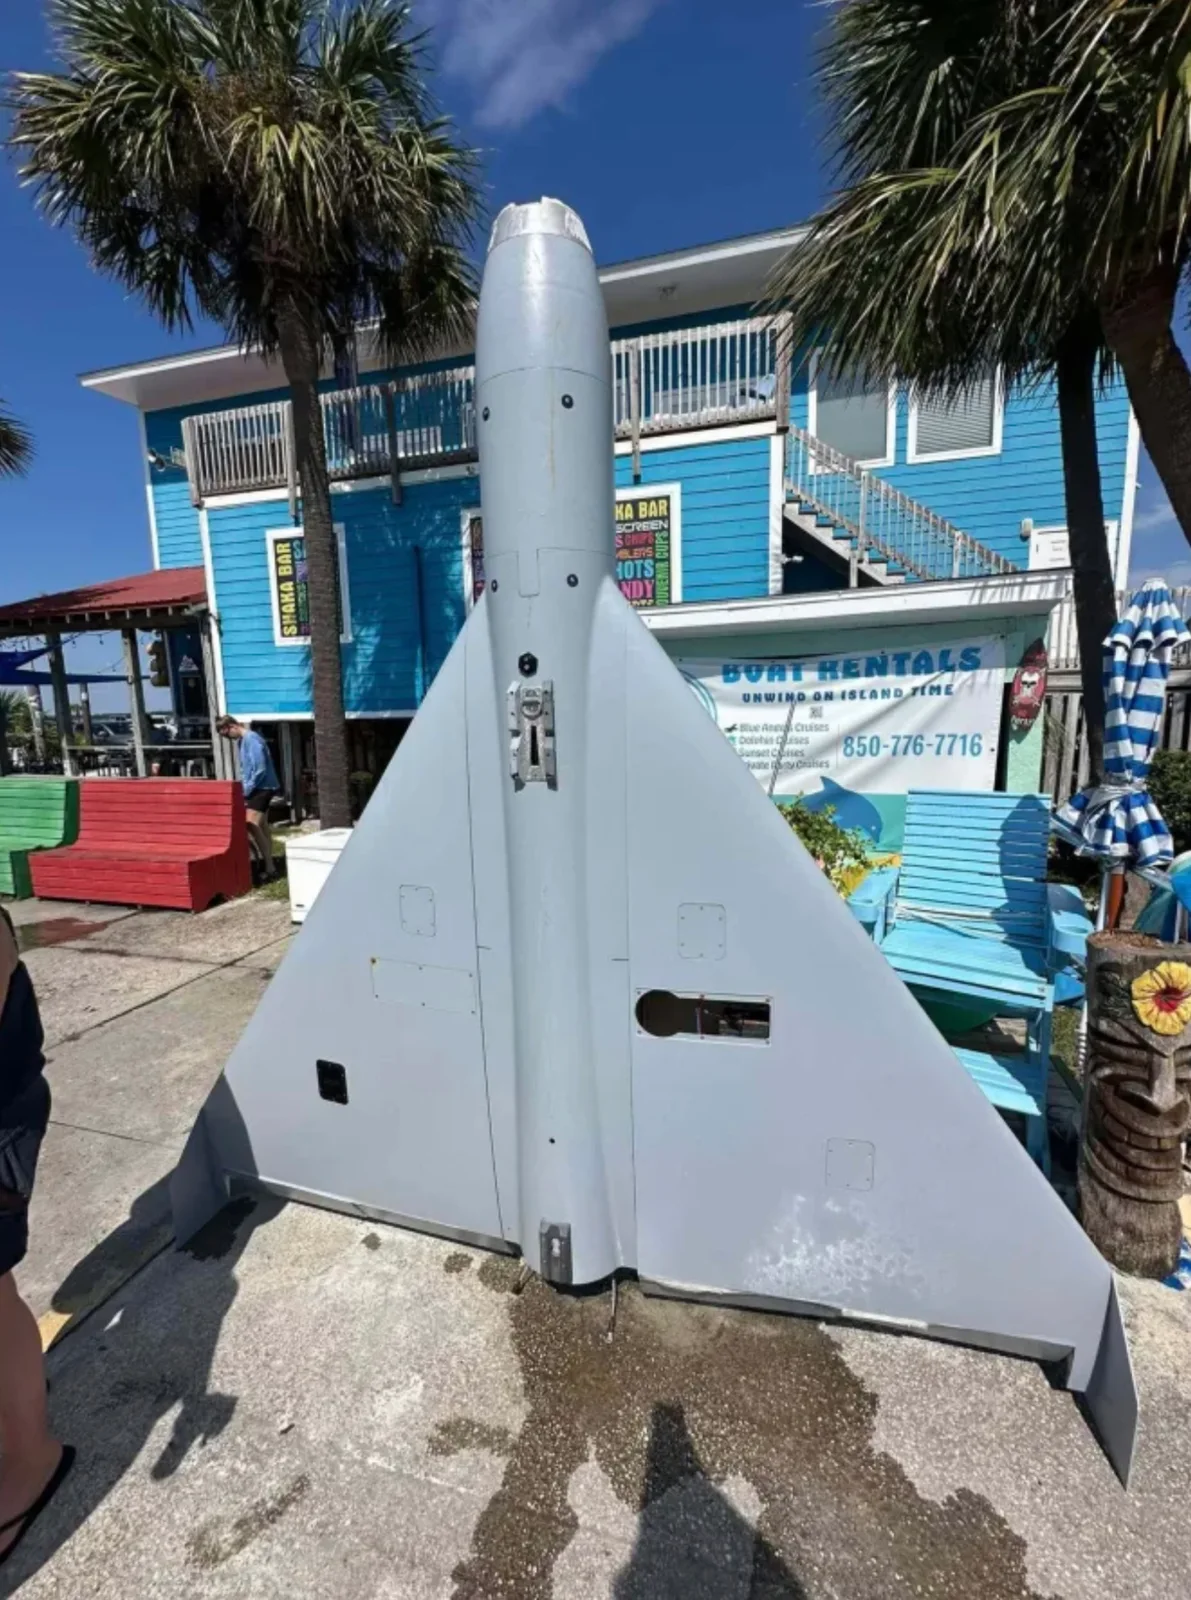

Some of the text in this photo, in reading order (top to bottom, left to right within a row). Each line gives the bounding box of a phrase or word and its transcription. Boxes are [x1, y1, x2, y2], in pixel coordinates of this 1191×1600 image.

[638, 499, 668, 518] BAR
[655, 531, 668, 559] CUPS
[276, 543, 297, 636] SHAKA BAR
[621, 579, 654, 599] NDY
[722, 647, 981, 683] BOAT RENTALS
[742, 684, 954, 703] UNWIND ON ISLAND TIME
[795, 723, 829, 732] Cruises
[776, 736, 809, 745] Cuises
[843, 733, 982, 757] 850-776-7716
[771, 748, 804, 757] Cuises
